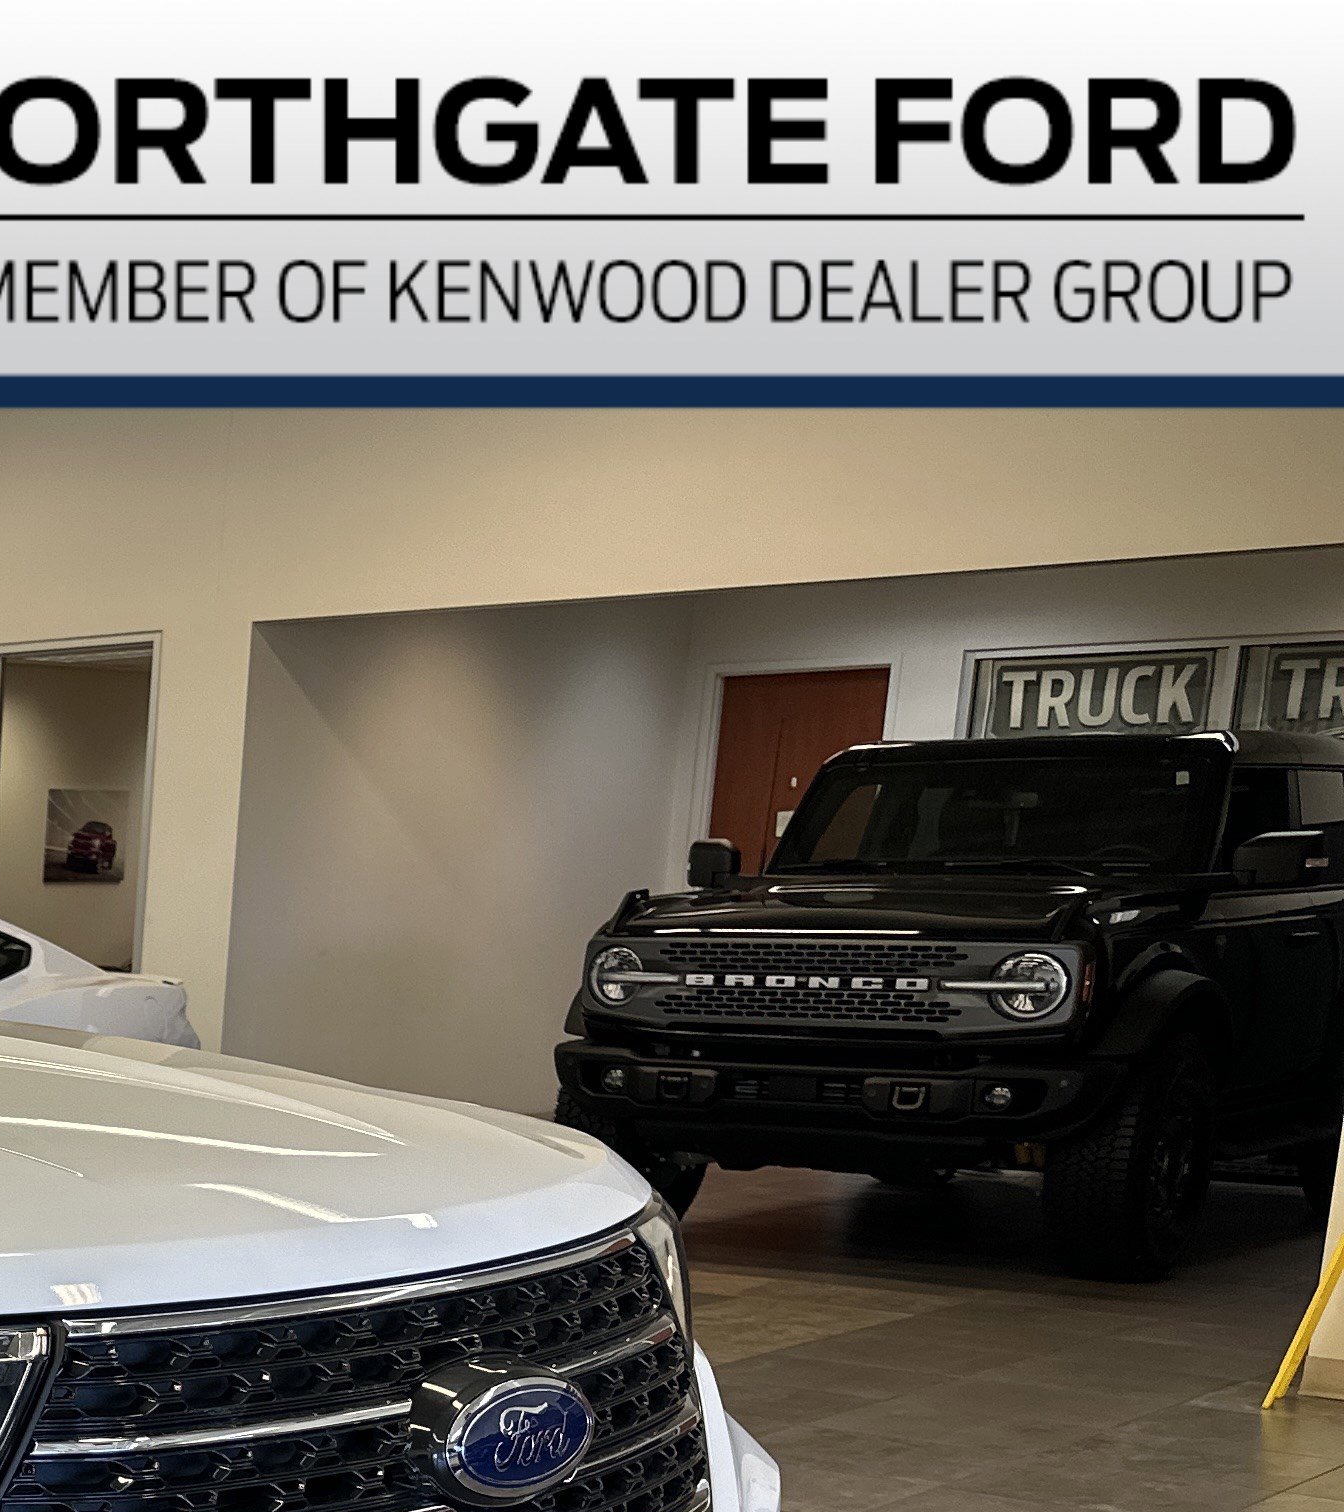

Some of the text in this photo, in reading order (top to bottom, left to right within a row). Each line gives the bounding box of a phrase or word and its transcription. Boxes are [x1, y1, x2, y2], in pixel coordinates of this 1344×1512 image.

[1002, 661, 1200, 730] TRUCK
[685, 973, 929, 991] BRONCO
[493, 1401, 572, 1474] Ford
